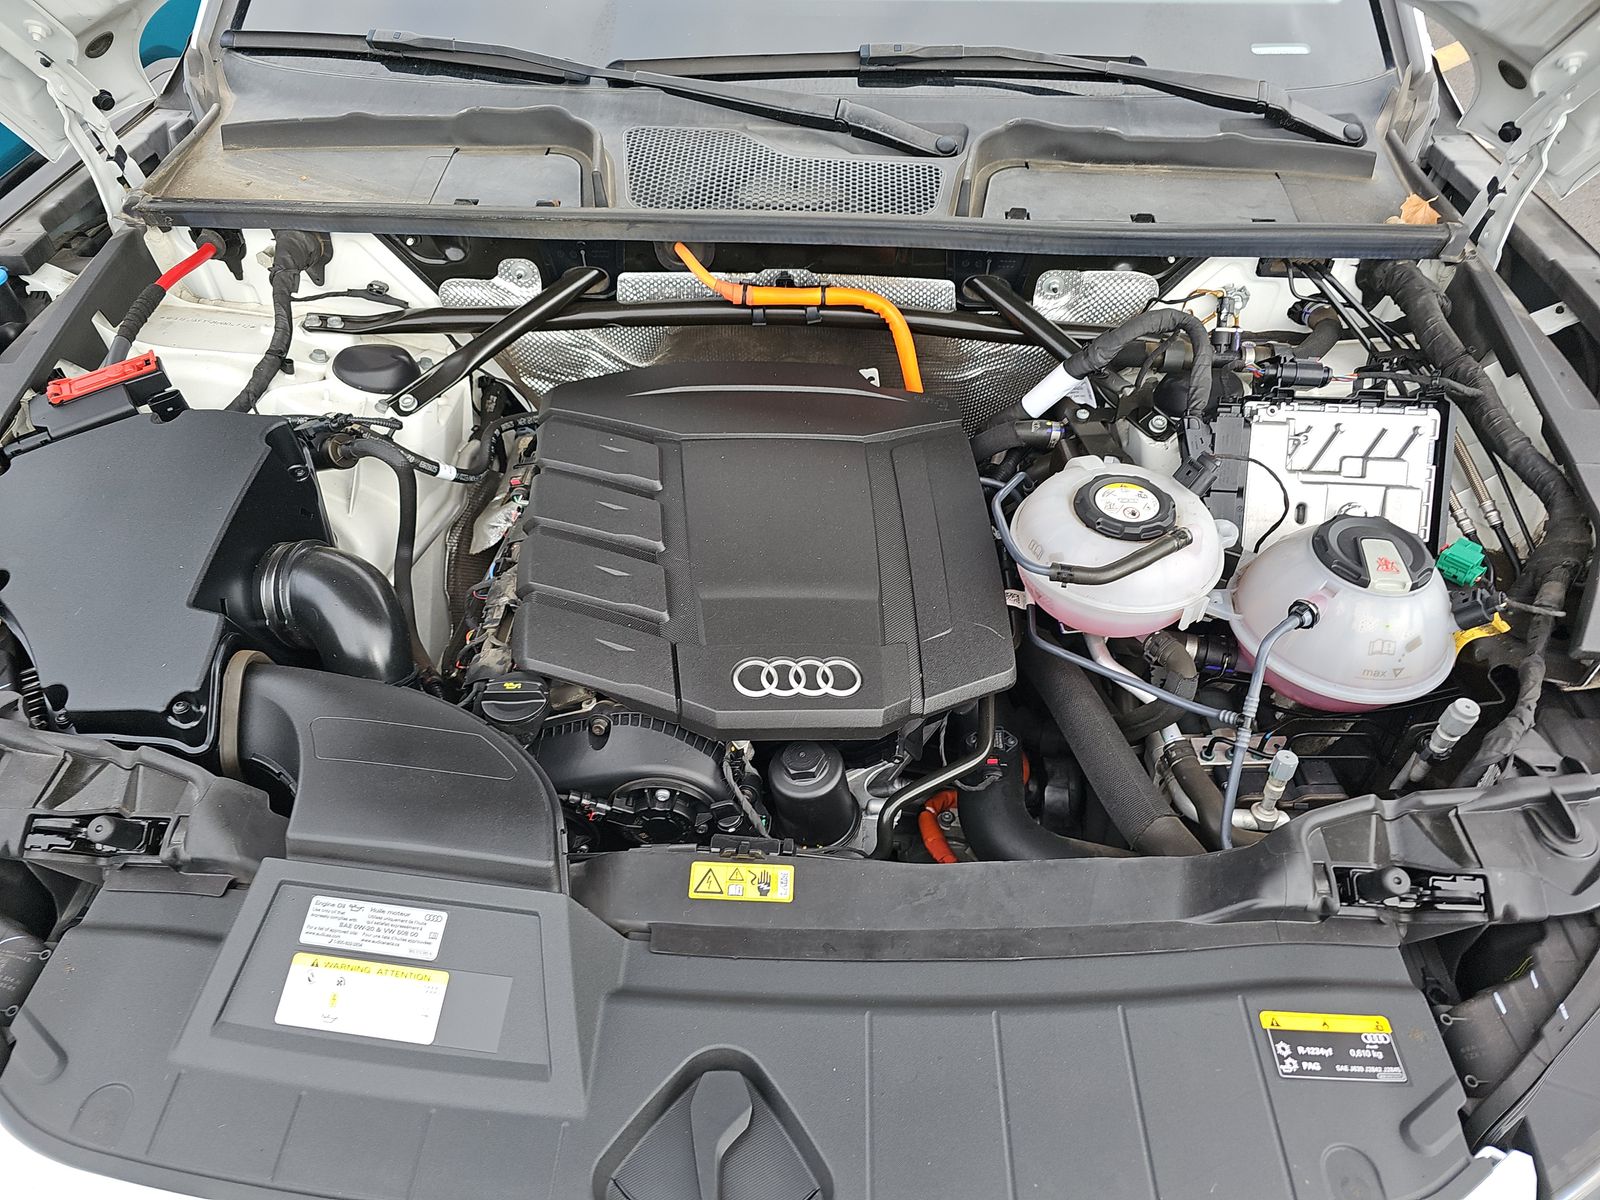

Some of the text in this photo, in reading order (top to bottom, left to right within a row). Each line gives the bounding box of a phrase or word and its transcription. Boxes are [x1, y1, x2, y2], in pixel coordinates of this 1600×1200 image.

[1361, 668, 1387, 678] max
[323, 961, 431, 982] WARNING ATTENTION
[1296, 1045, 1333, 1057] R-1234yf
[1371, 1049, 1384, 1060] kg
[1301, 1061, 1322, 1071] PAG
[1335, 1064, 1349, 1072] SAE
